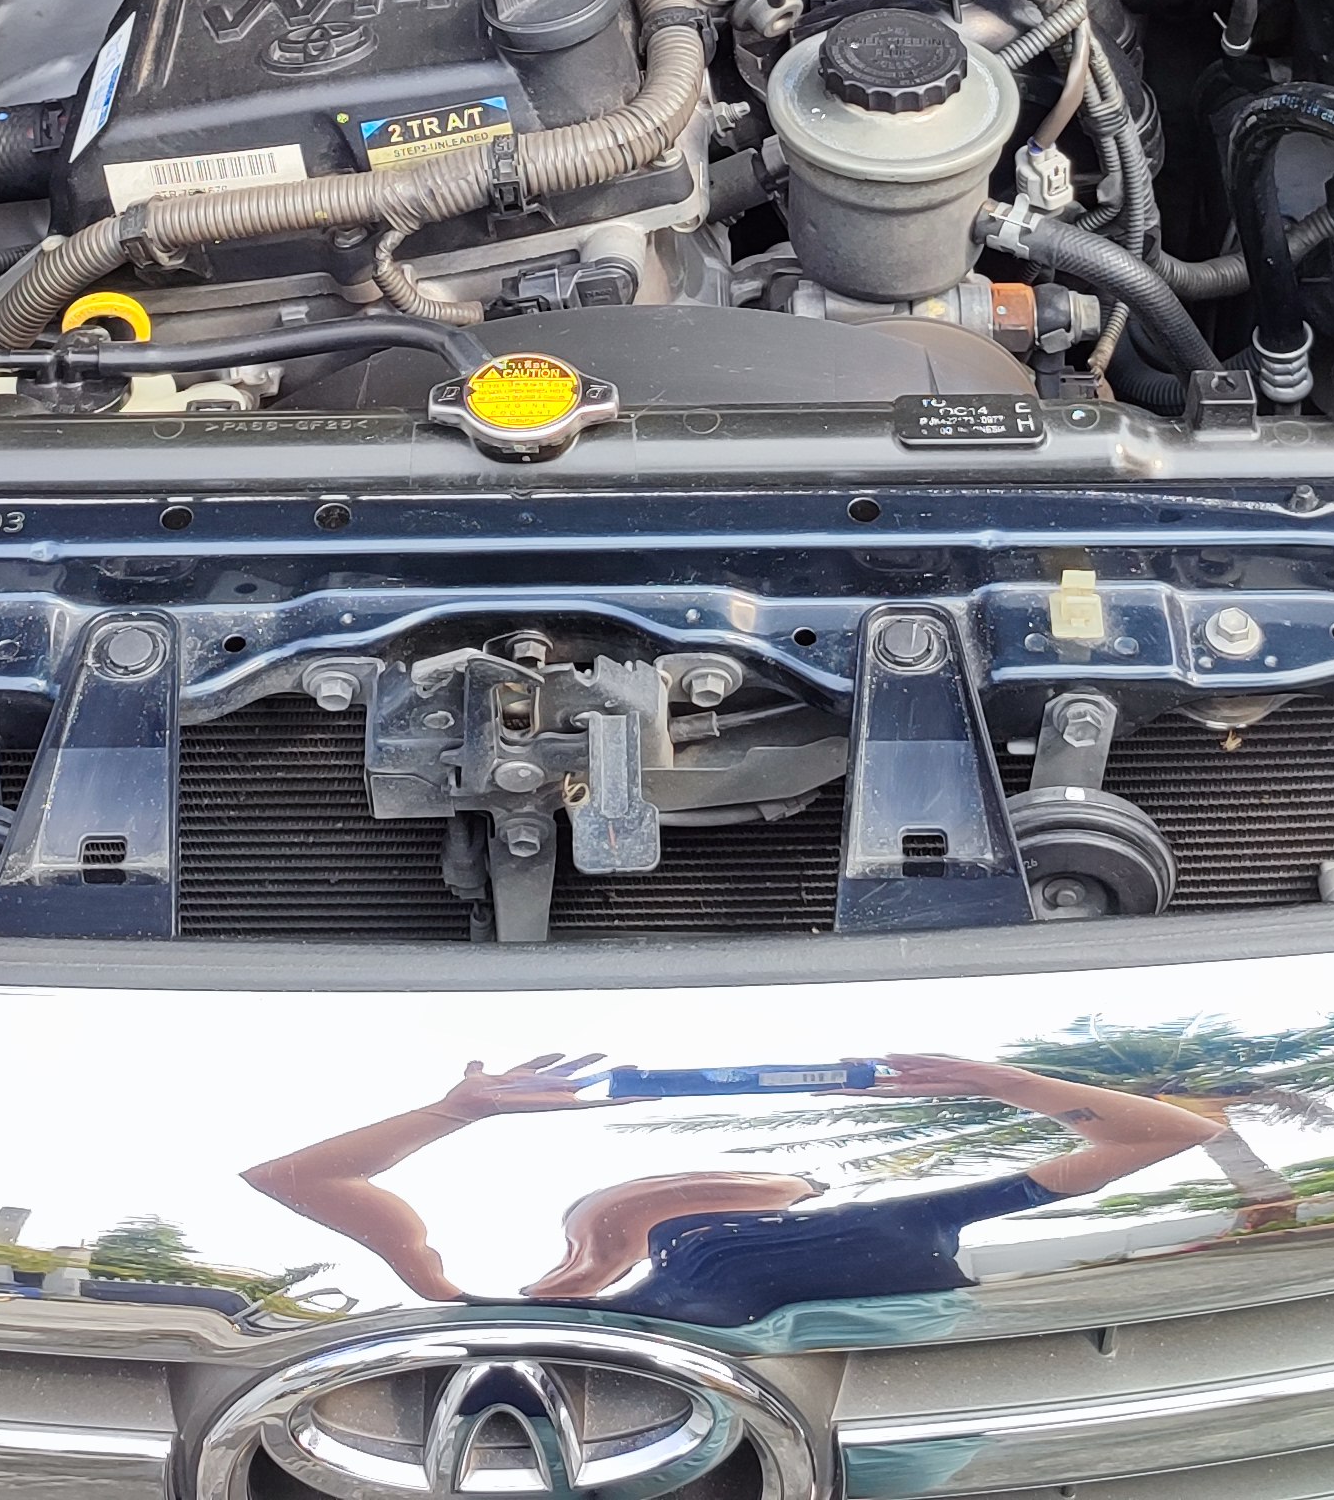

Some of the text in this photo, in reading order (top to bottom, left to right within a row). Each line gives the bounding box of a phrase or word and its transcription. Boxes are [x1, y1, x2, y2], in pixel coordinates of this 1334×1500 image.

[388, 106, 483, 143] 2 TR A/T
[393, 132, 489, 158] STEP2-UNLEADED
[503, 369, 561, 378] CAUTION
